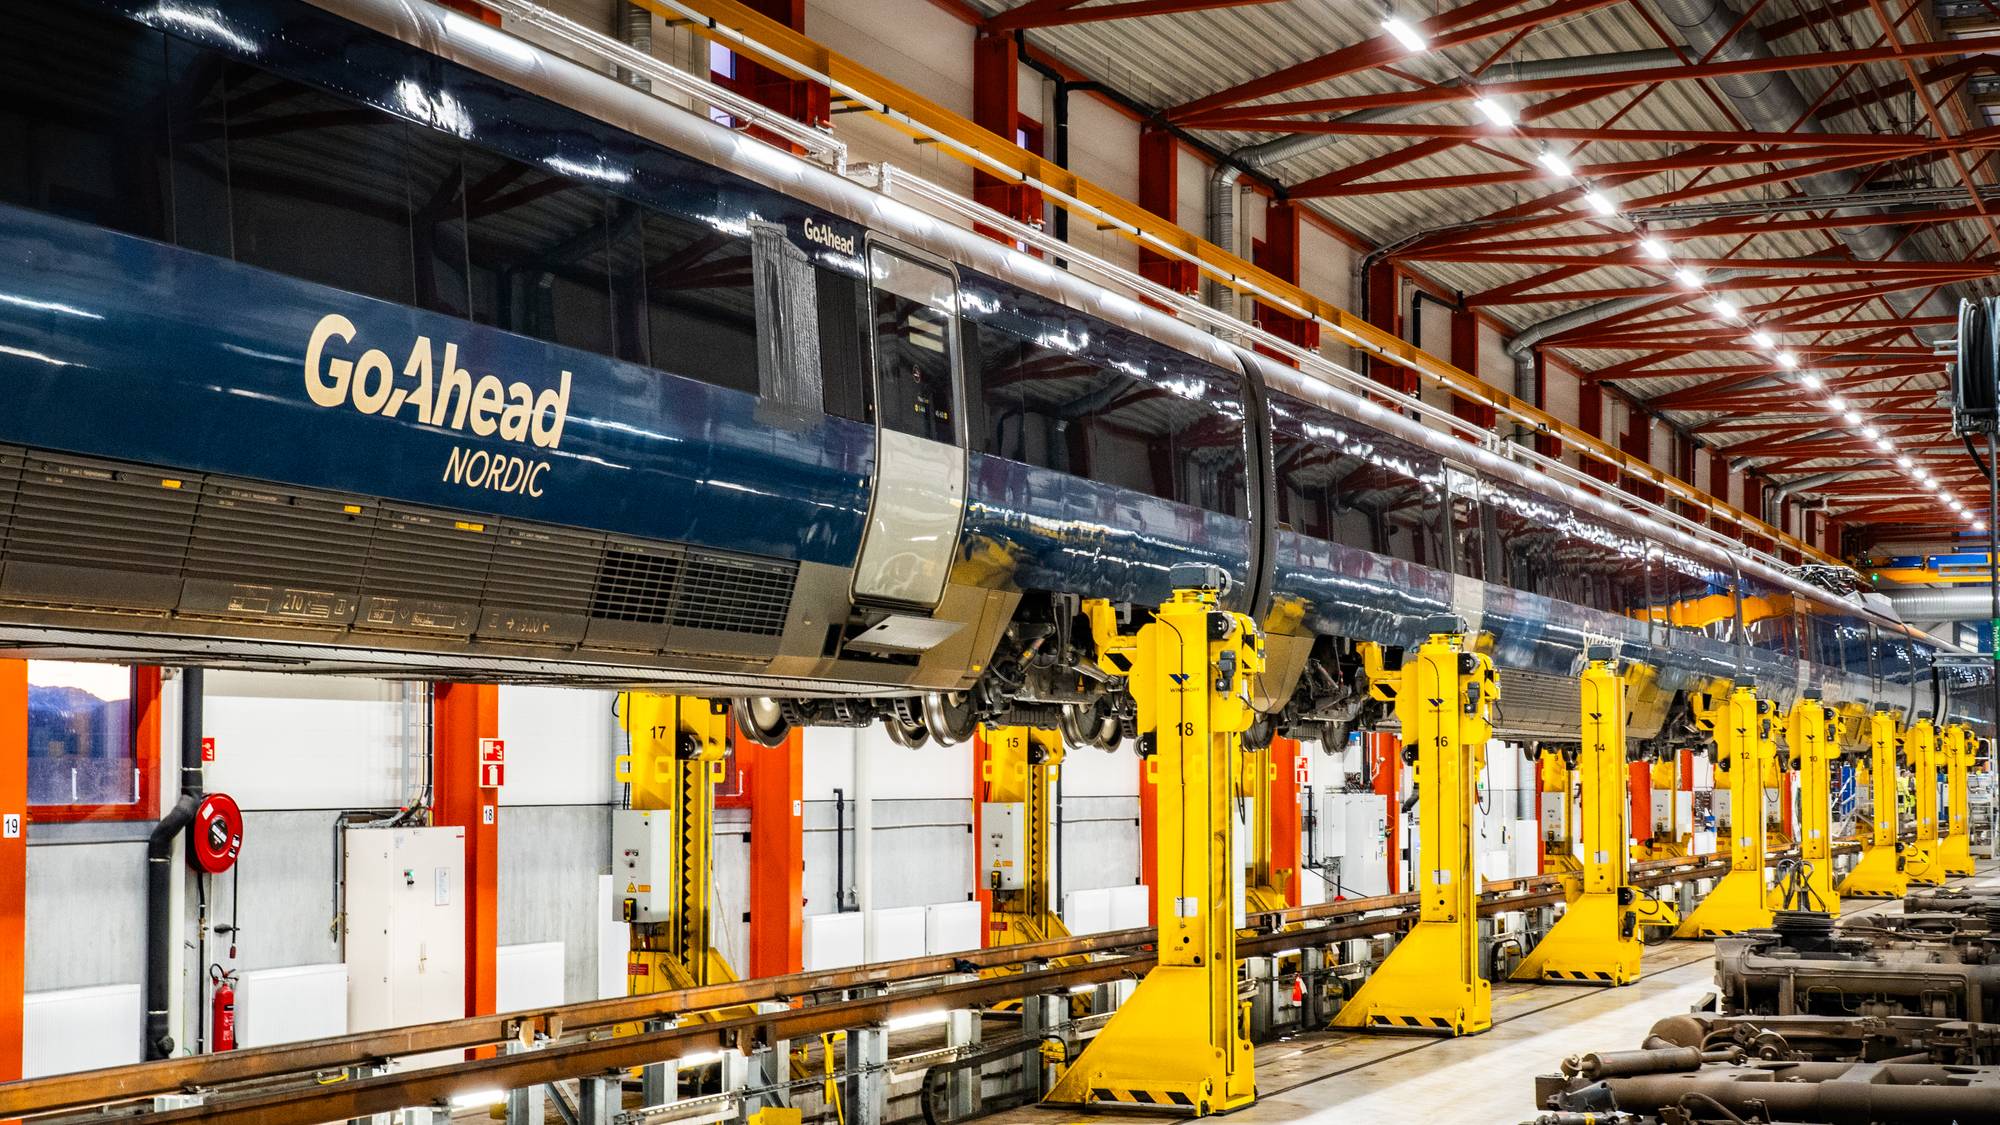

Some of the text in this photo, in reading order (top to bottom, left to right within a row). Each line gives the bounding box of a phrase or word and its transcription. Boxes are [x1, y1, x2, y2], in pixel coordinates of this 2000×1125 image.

[803, 217, 854, 256] GoAhead
[304, 313, 573, 449] GoAhead
[443, 446, 551, 498] NORDIC
[282, 593, 304, 611] 210
[650, 725, 667, 739] 17
[1175, 721, 1194, 737] 18
[1006, 737, 1019, 748] 15
[1433, 735, 1449, 748] 16
[1593, 743, 1606, 753] 14
[1740, 751, 1750, 760] 12
[484, 808, 493, 821] 18
[5, 818, 18, 834] 19
